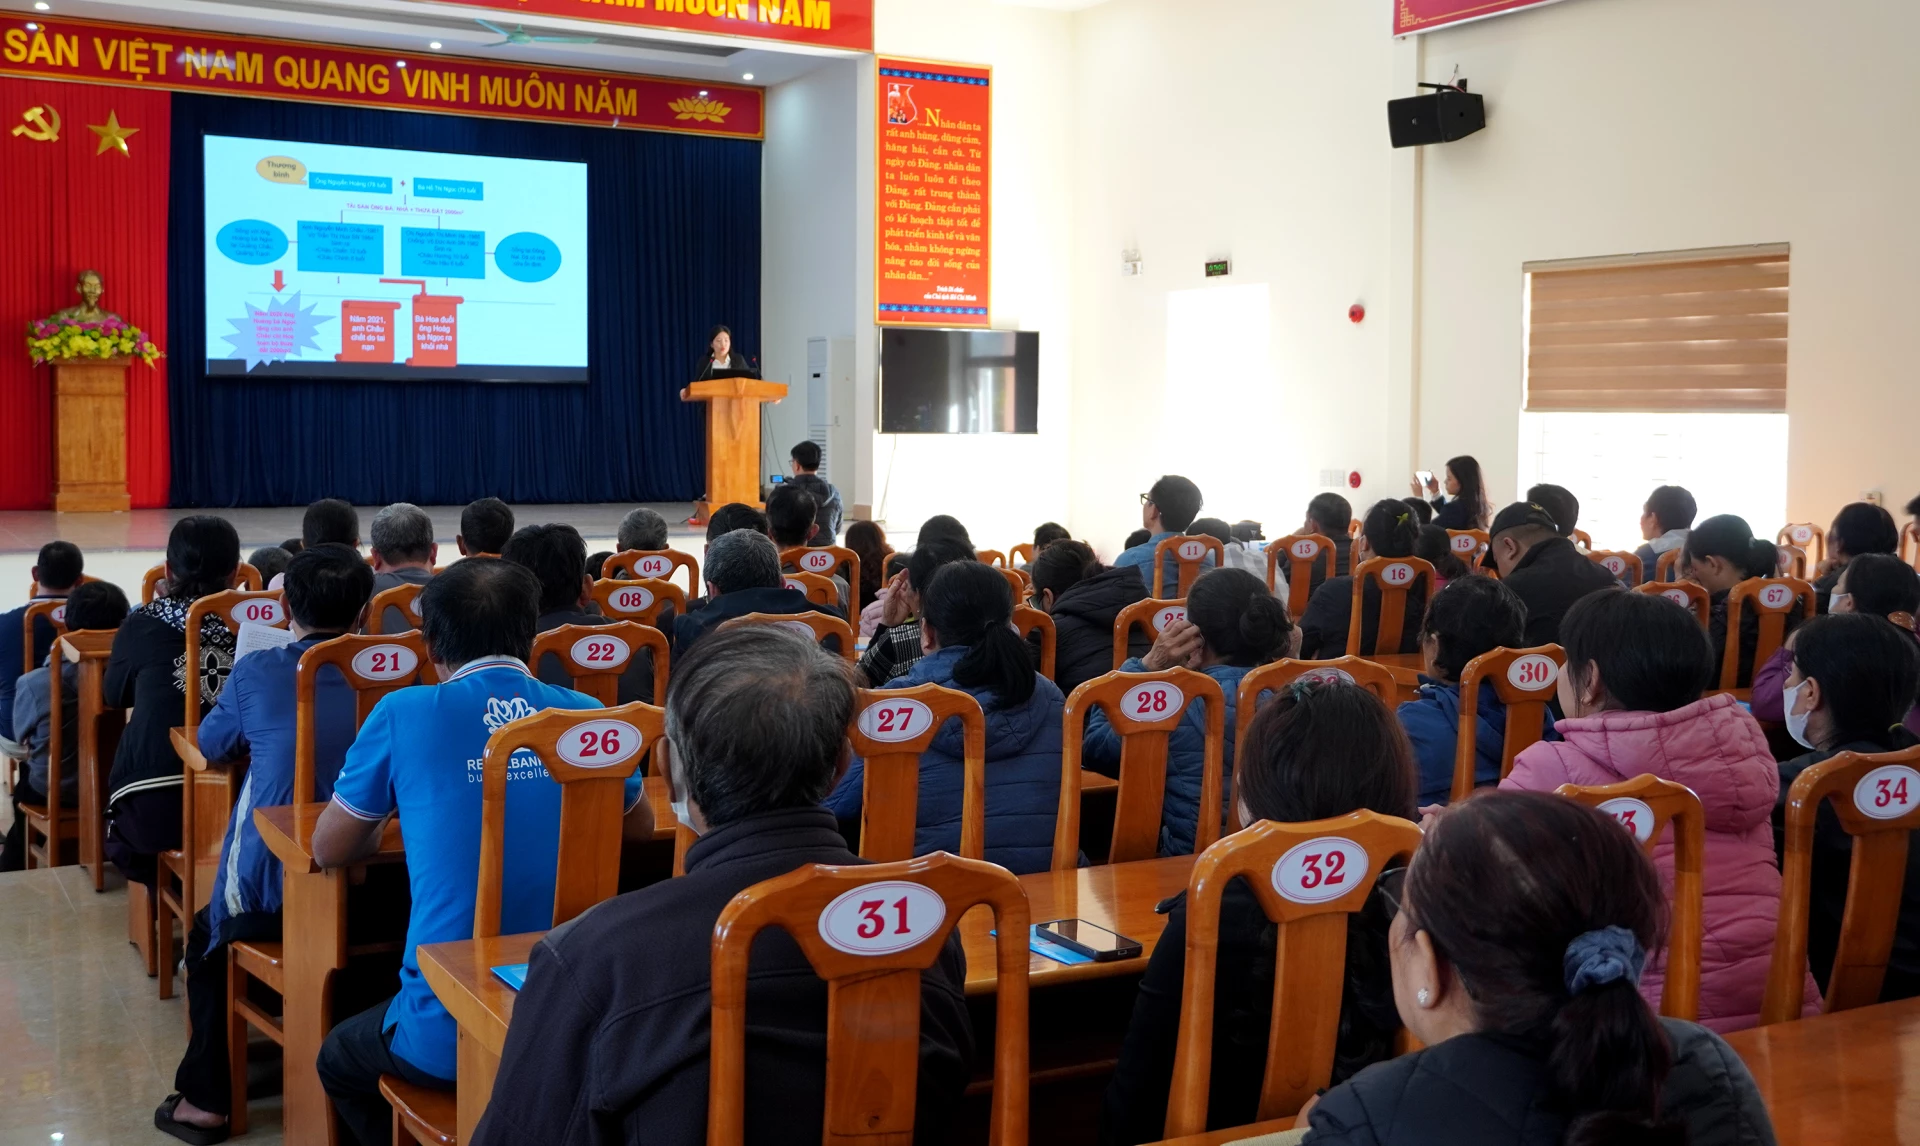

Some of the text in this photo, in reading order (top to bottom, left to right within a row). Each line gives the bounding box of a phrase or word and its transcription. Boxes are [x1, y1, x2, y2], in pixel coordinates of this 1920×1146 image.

[4, 23, 638, 117] SẢN VIỆT NAM QUANG VINH MUÔN NĂM
[973, 123, 981, 131] ta
[886, 127, 898, 136] rất
[900, 129, 915, 139] anh
[941, 132, 961, 144] dũng
[885, 142, 908, 154] hăng
[933, 145, 948, 155] cần
[969, 148, 981, 158] Từ
[267, 160, 296, 171] Thương
[885, 157, 905, 167] ngày
[907, 158, 916, 167] có
[944, 160, 964, 171] nhân
[966, 163, 981, 172] dân
[885, 172, 981, 186] ta luôn luôn đi theo
[914, 187, 926, 197] rất
[931, 189, 953, 199] trung
[957, 190, 981, 200] thành
[885, 199, 897, 208] với
[925, 201, 946, 213] Đảng
[947, 202, 961, 213] cần
[963, 205, 980, 214] phải
[885, 213, 981, 228] có kế hoạch thật tốt để
[885, 228, 980, 242] phát triển kinh tế và văn
[904, 242, 927, 252] nhằm
[930, 244, 954, 256] không
[956, 248, 980, 257] ngừng
[885, 257, 905, 267] nâng
[927, 258, 940, 267] đời
[944, 259, 962, 269] sống
[966, 259, 980, 269] của
[885, 270, 905, 280] nhân
[419, 324, 431, 332] ông
[1298, 544, 1311, 554] 13
[1457, 538, 1469, 548] 15
[1186, 546, 1198, 556] 11
[643, 560, 662, 572] 04
[810, 555, 827, 567] 05
[1607, 561, 1618, 572] 18
[1392, 568, 1406, 580] 16
[619, 592, 642, 607] 08
[1767, 589, 1783, 602] 67
[246, 604, 273, 620] 06
[587, 642, 615, 661] 22
[371, 652, 400, 672] 21
[1519, 662, 1548, 683] 30
[1137, 690, 1167, 713] 28
[877, 707, 914, 732] 27
[579, 729, 620, 757] 26
[1875, 777, 1907, 807] 34
[1301, 850, 1345, 888] 32
[857, 896, 911, 938] 31
